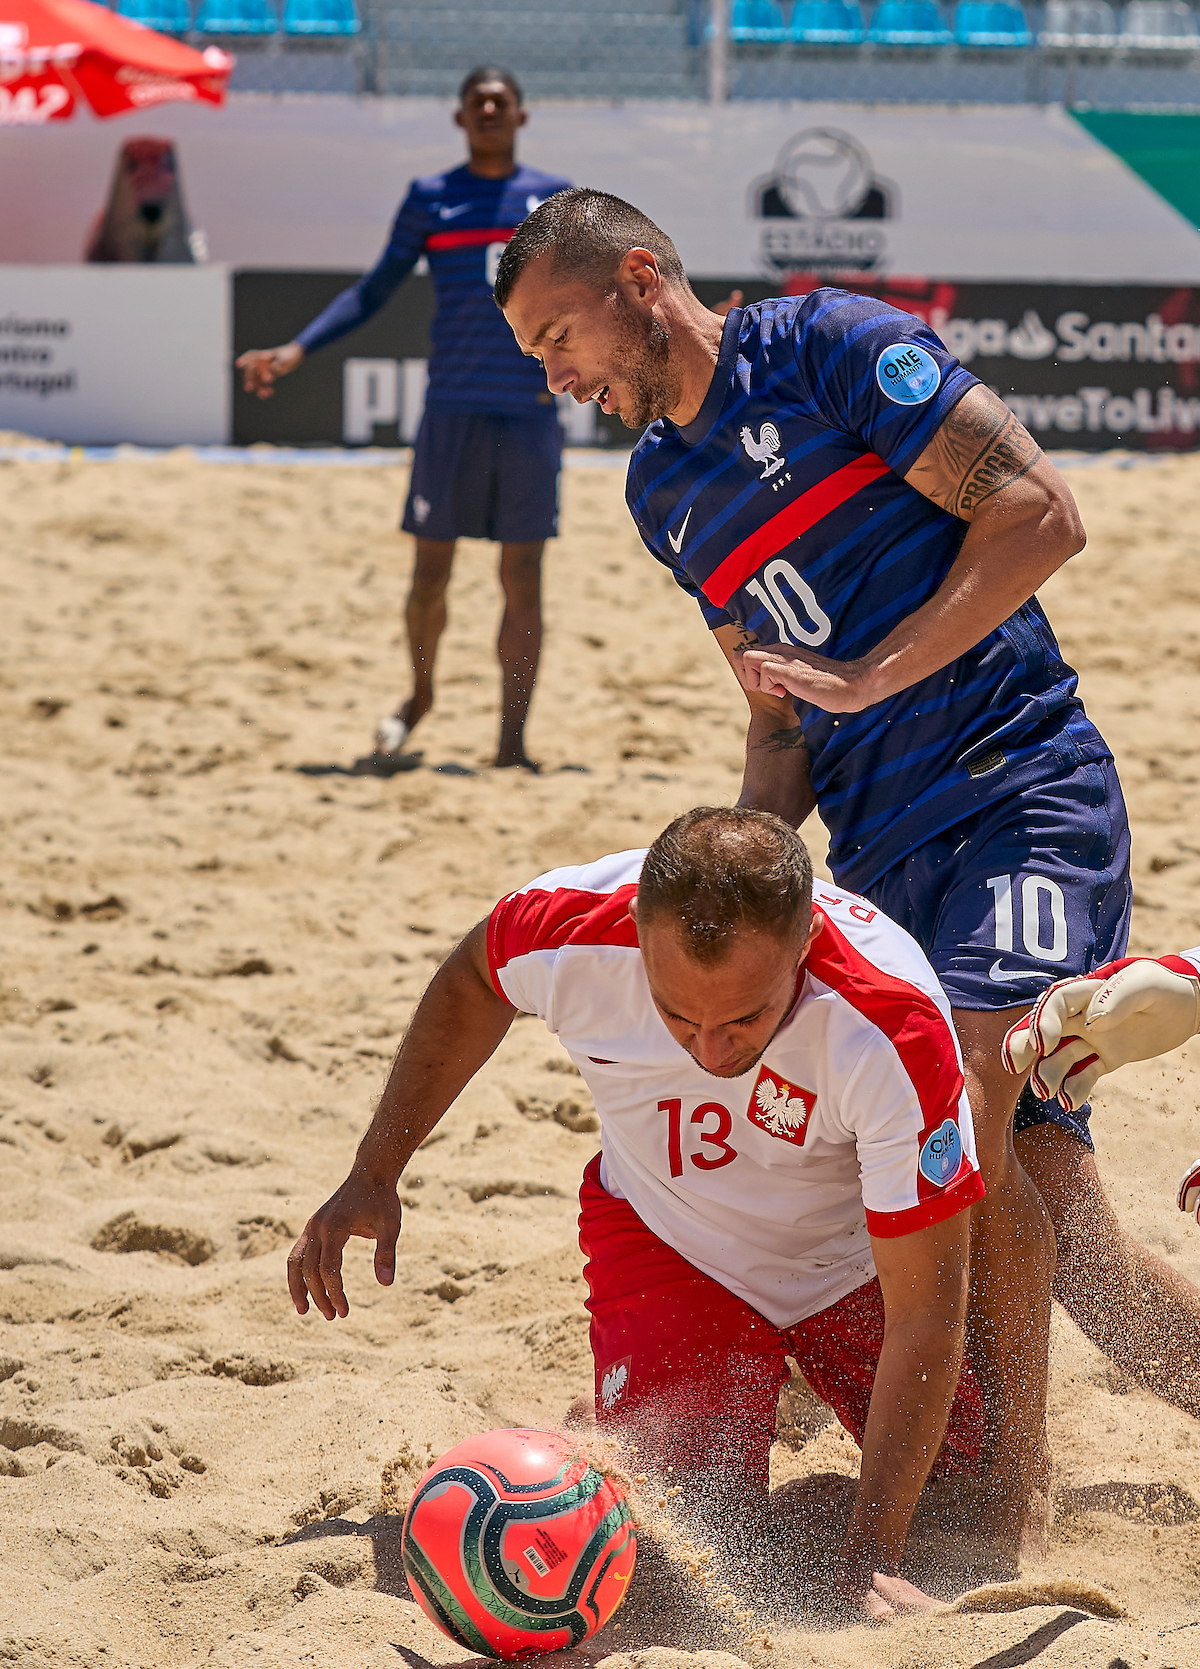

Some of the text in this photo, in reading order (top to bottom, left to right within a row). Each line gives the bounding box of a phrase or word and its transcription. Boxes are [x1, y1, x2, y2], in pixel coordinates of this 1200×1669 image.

[883, 349, 921, 379] ONE
[911, 306, 1008, 364] iga
[890, 360, 924, 387] HUMANITY
[772, 472, 793, 491] FFF
[744, 558, 832, 648] 10
[986, 873, 1068, 962] 10
[657, 1097, 739, 1179] 13
